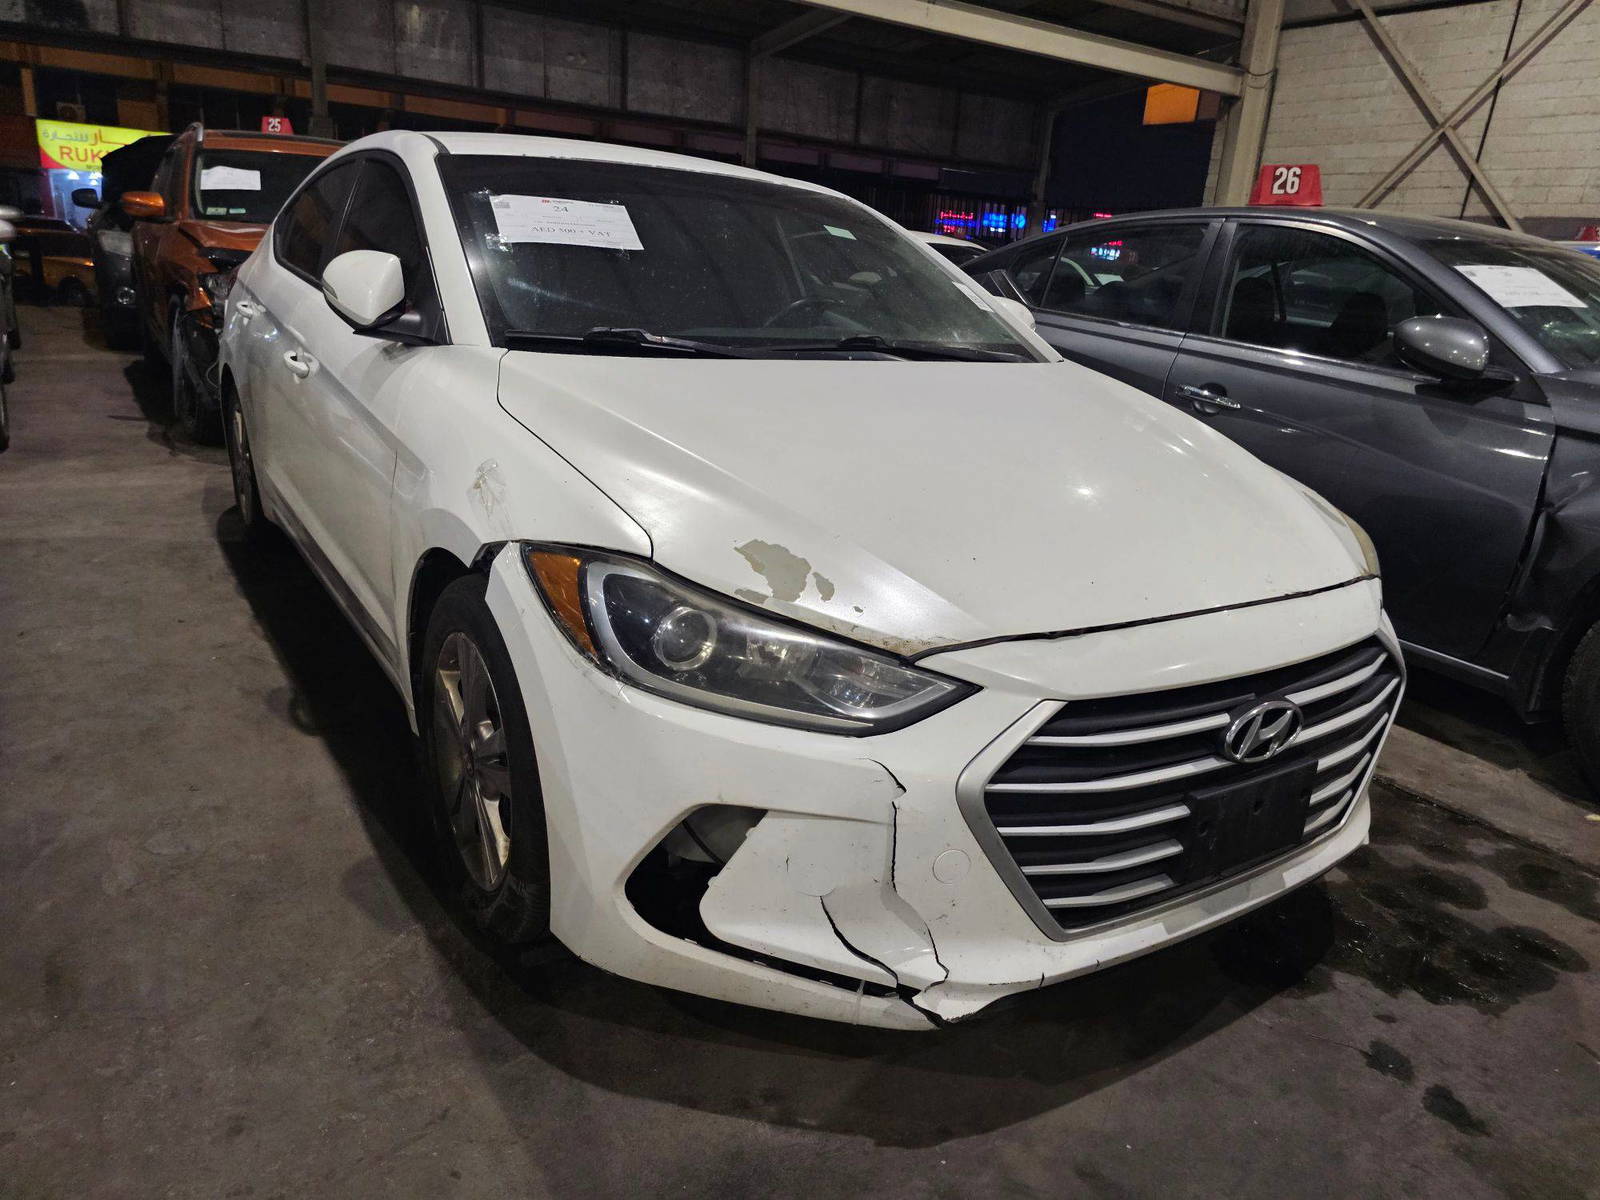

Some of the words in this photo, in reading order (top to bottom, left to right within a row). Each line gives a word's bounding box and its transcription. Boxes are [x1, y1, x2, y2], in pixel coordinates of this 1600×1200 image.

[268, 118, 281, 132] 25
[58, 145, 112, 164] RUK
[1272, 167, 1302, 195] 26
